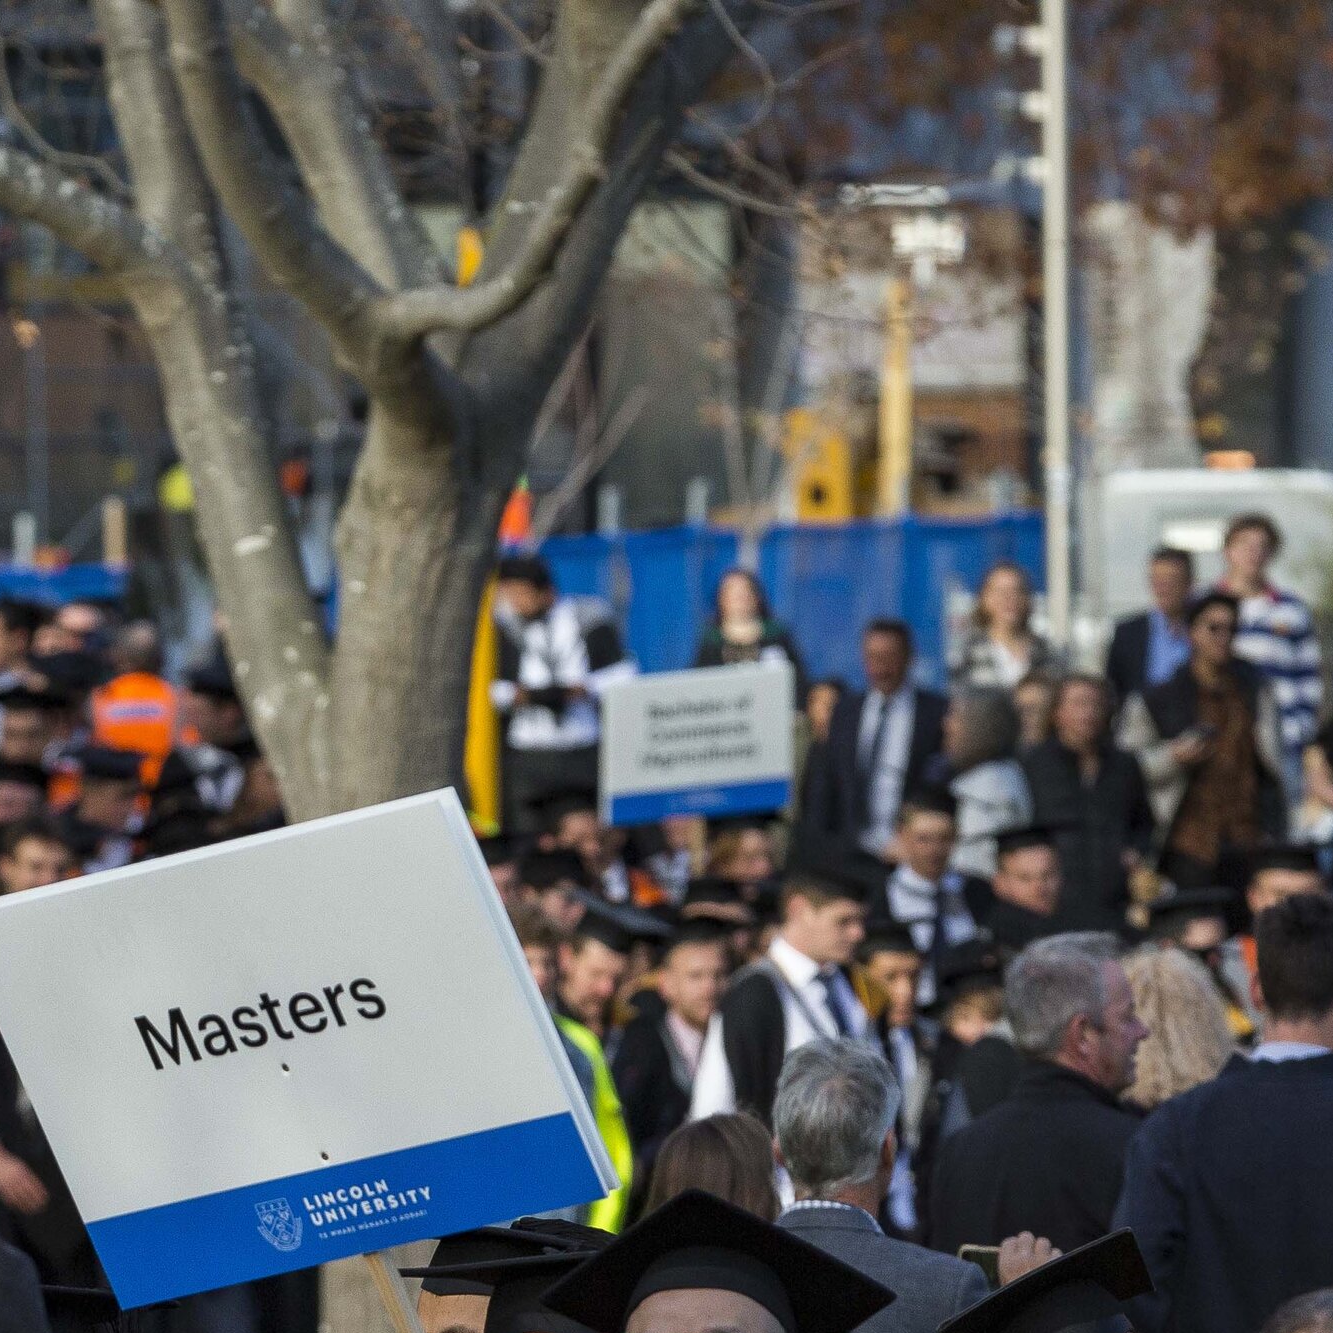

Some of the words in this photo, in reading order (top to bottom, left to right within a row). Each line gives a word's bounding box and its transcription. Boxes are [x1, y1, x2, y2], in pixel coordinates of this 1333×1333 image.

[133, 977, 388, 1071] Masters
[303, 1179, 389, 1211] LINCOLN
[309, 1186, 431, 1226] UNIVERSITY
